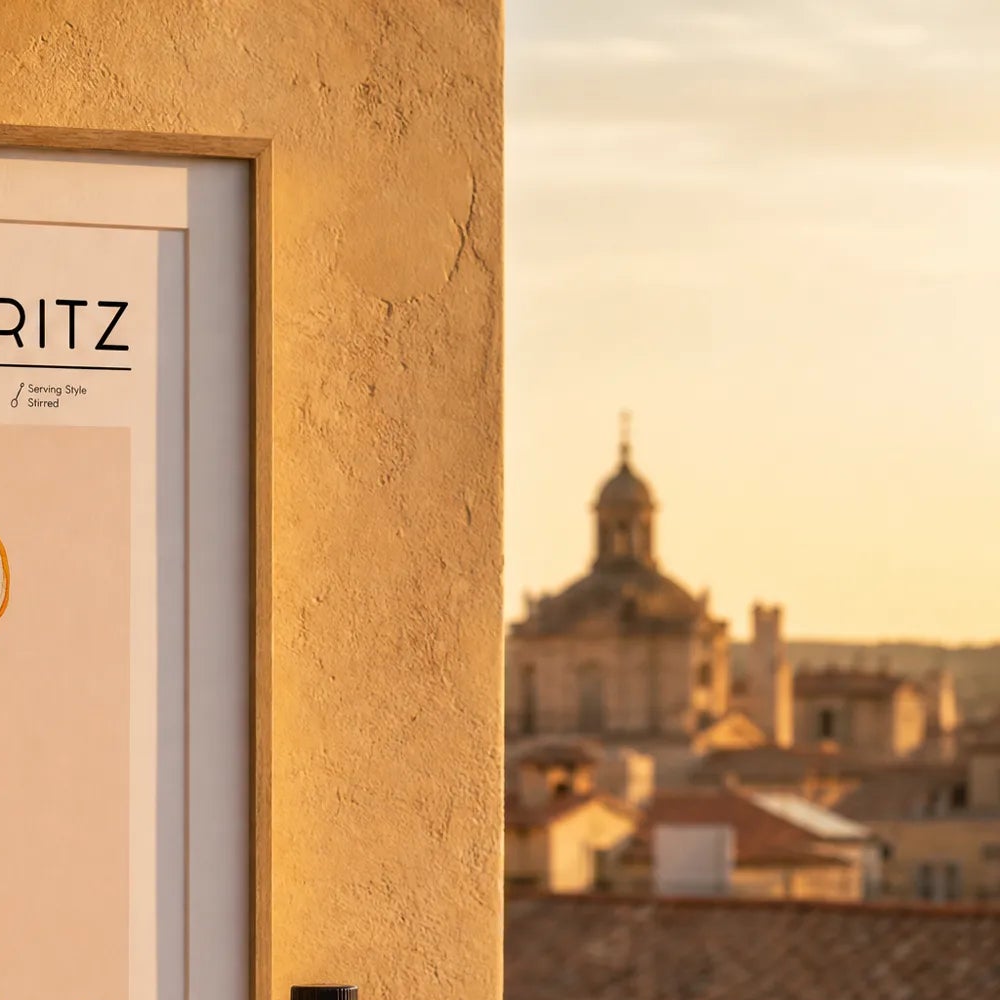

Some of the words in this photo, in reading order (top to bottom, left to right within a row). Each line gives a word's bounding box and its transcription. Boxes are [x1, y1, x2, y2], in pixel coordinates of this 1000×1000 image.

[28, 383, 62, 397] Serving
[65, 384, 87, 397] Style
[27, 397, 60, 409] Stirred
